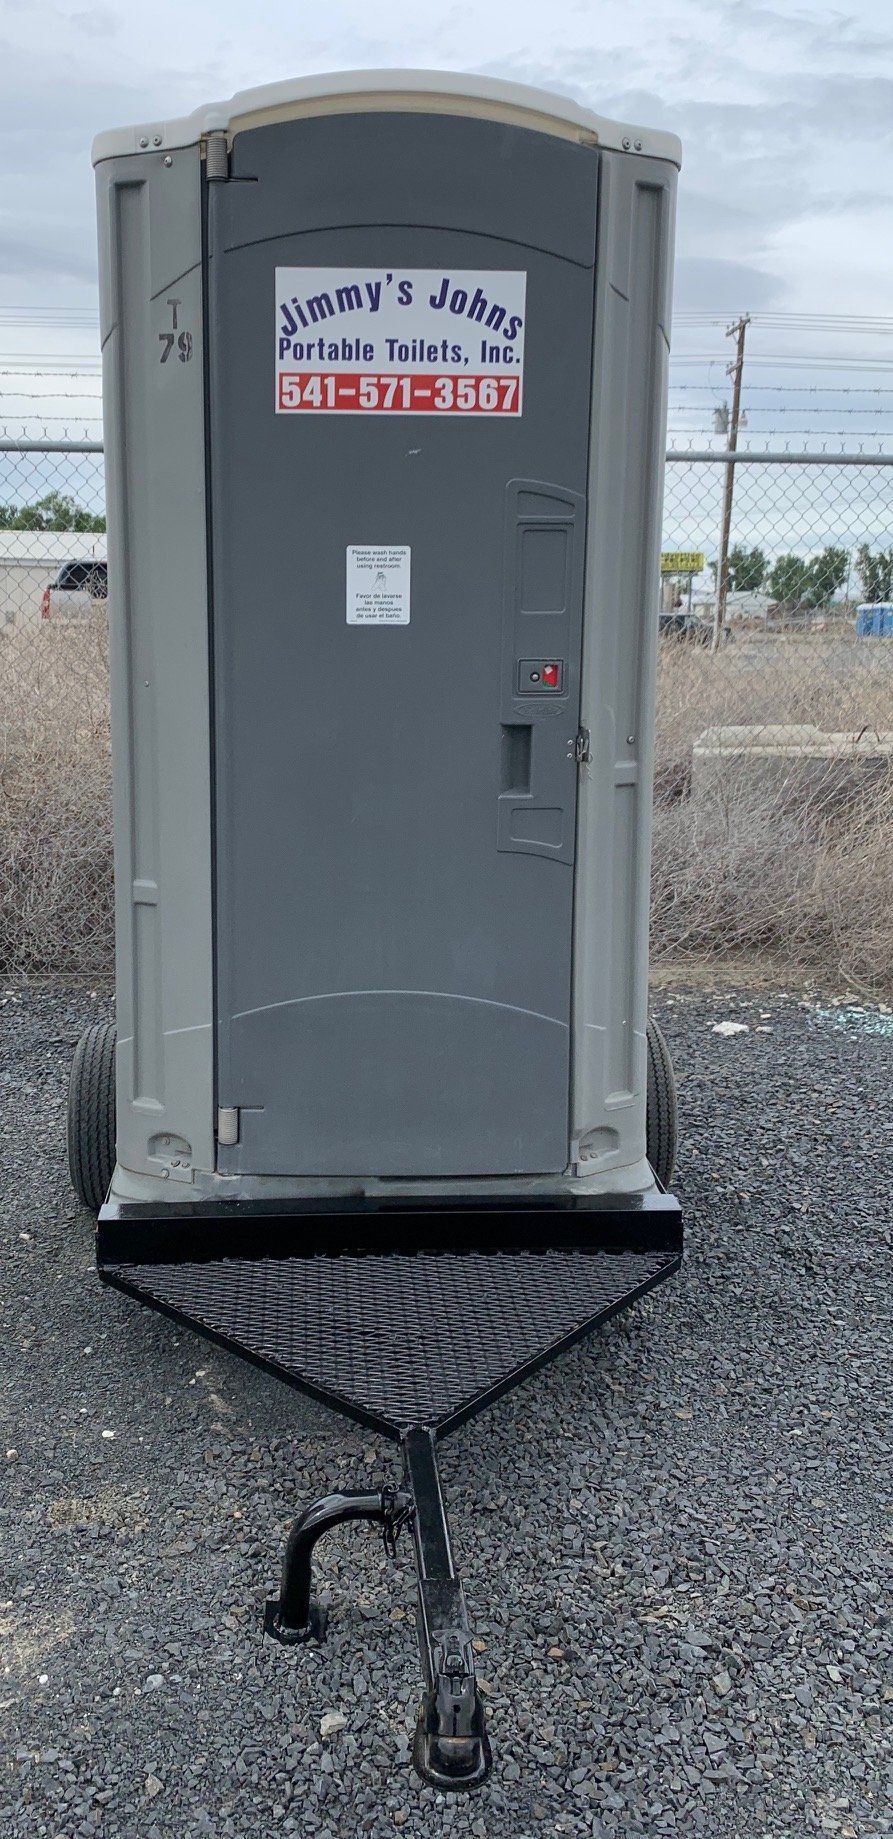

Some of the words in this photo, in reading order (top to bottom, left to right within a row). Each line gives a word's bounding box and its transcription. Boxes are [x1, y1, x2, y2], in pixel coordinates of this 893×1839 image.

[167, 299, 182, 329] T
[279, 273, 414, 337] Jimmy's
[429, 277, 523, 341] Johns
[278, 337, 374, 361] Portable
[385, 338, 469, 366] Toilets,
[480, 340, 521, 364] Inc.
[281, 375, 518, 410] 541-571-3567
